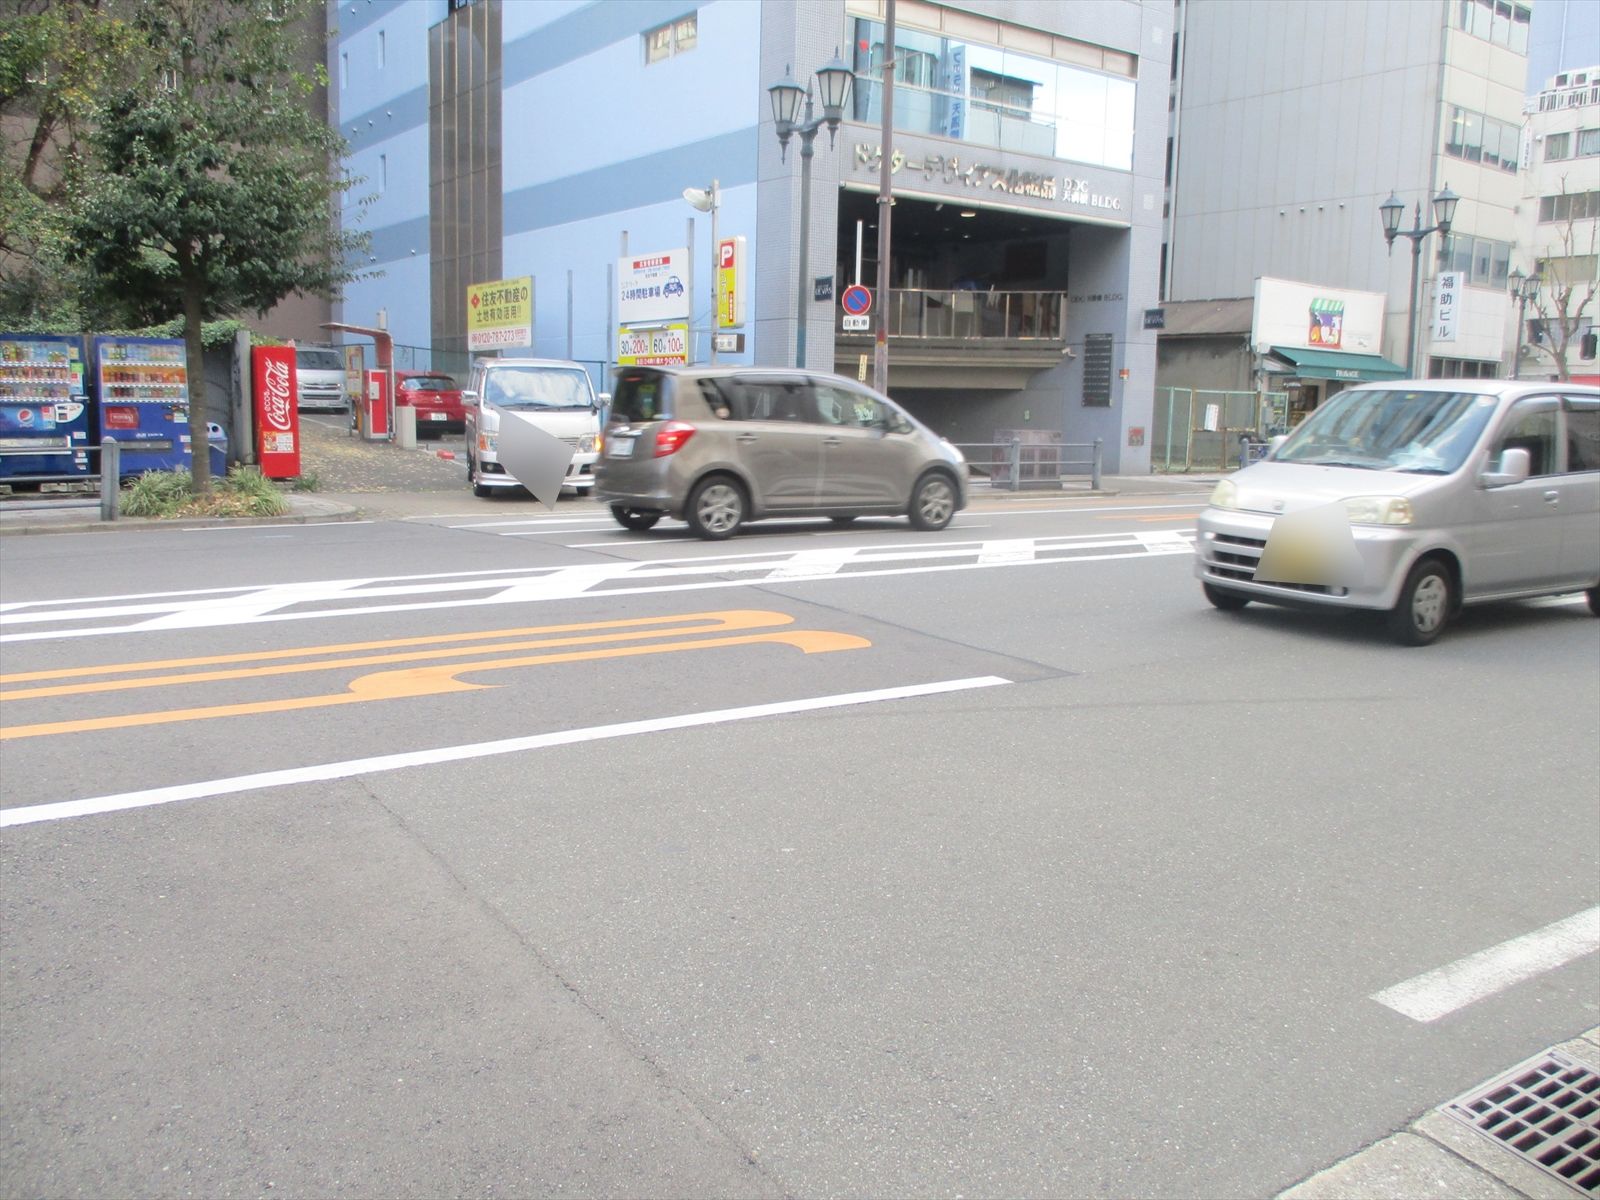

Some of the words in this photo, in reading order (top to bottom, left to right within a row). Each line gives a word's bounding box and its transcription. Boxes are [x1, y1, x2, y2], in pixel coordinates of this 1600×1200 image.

[481, 286, 528, 307] 住友不動産の
[1439, 276, 1454, 338] 福助ビル
[844, 319, 868, 328] 自動車
